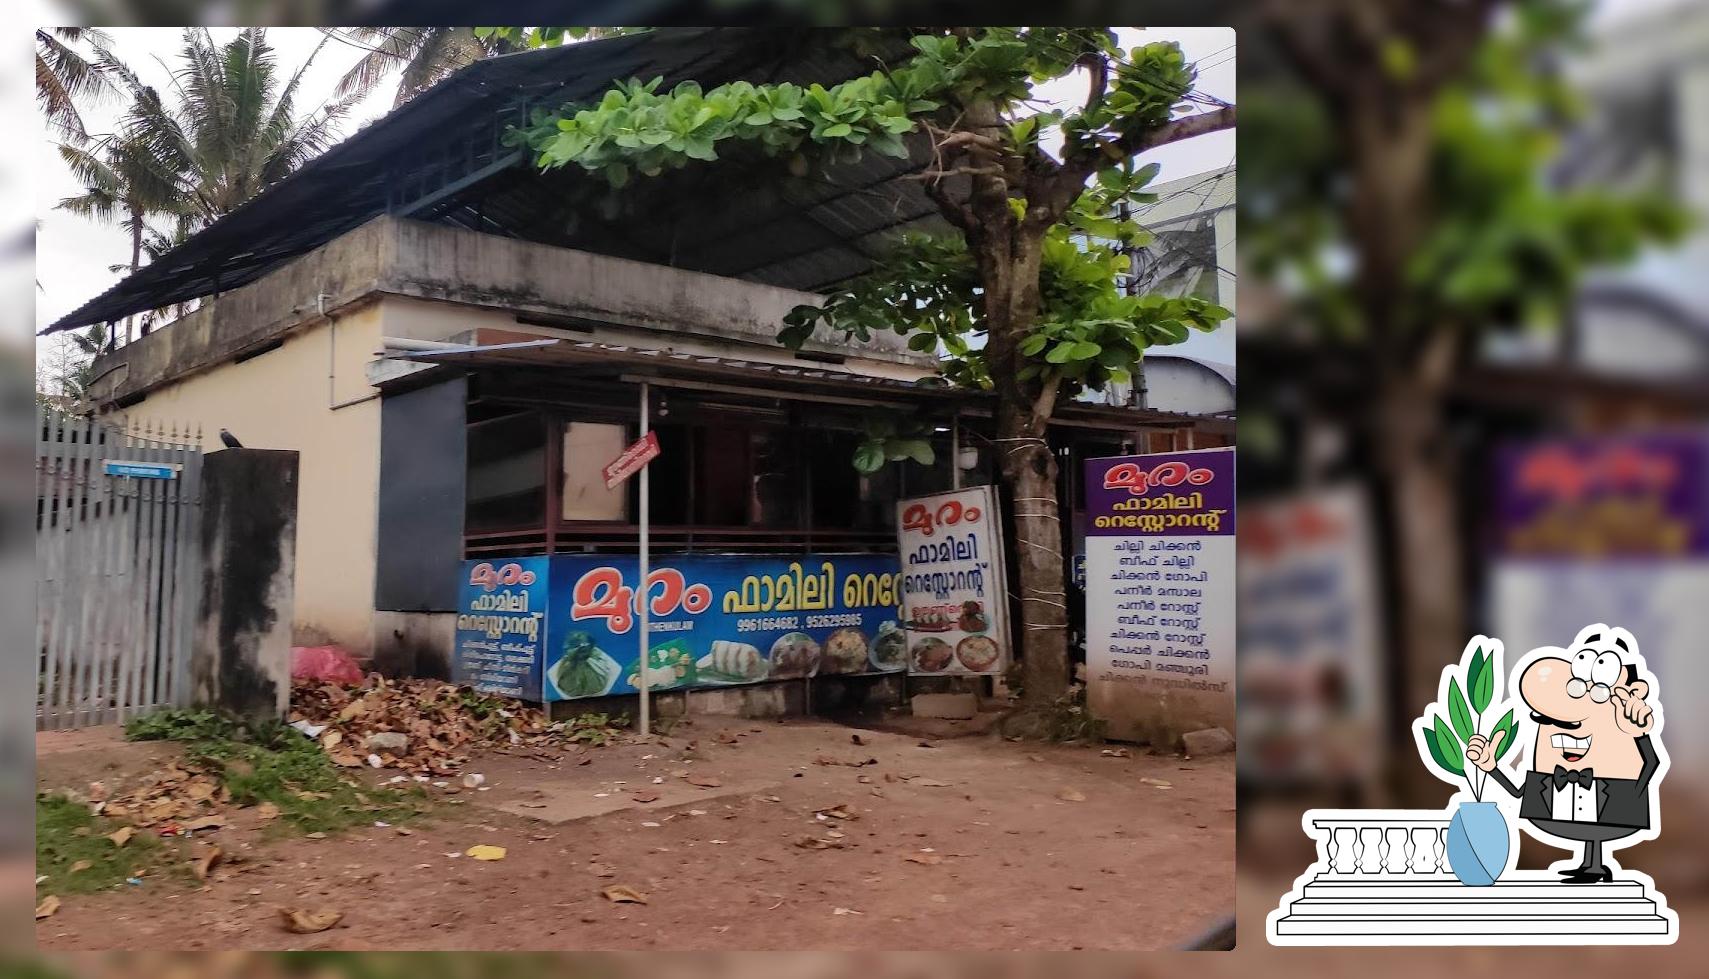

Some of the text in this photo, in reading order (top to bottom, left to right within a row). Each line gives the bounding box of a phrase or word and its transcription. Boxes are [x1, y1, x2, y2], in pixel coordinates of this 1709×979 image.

[1112, 492, 1203, 511] ഫാമിലി
[909, 532, 978, 565] ഫാമിലി
[470, 589, 529, 612] ഫാമിലി
[722, 561, 835, 614] ഫാമിലി
